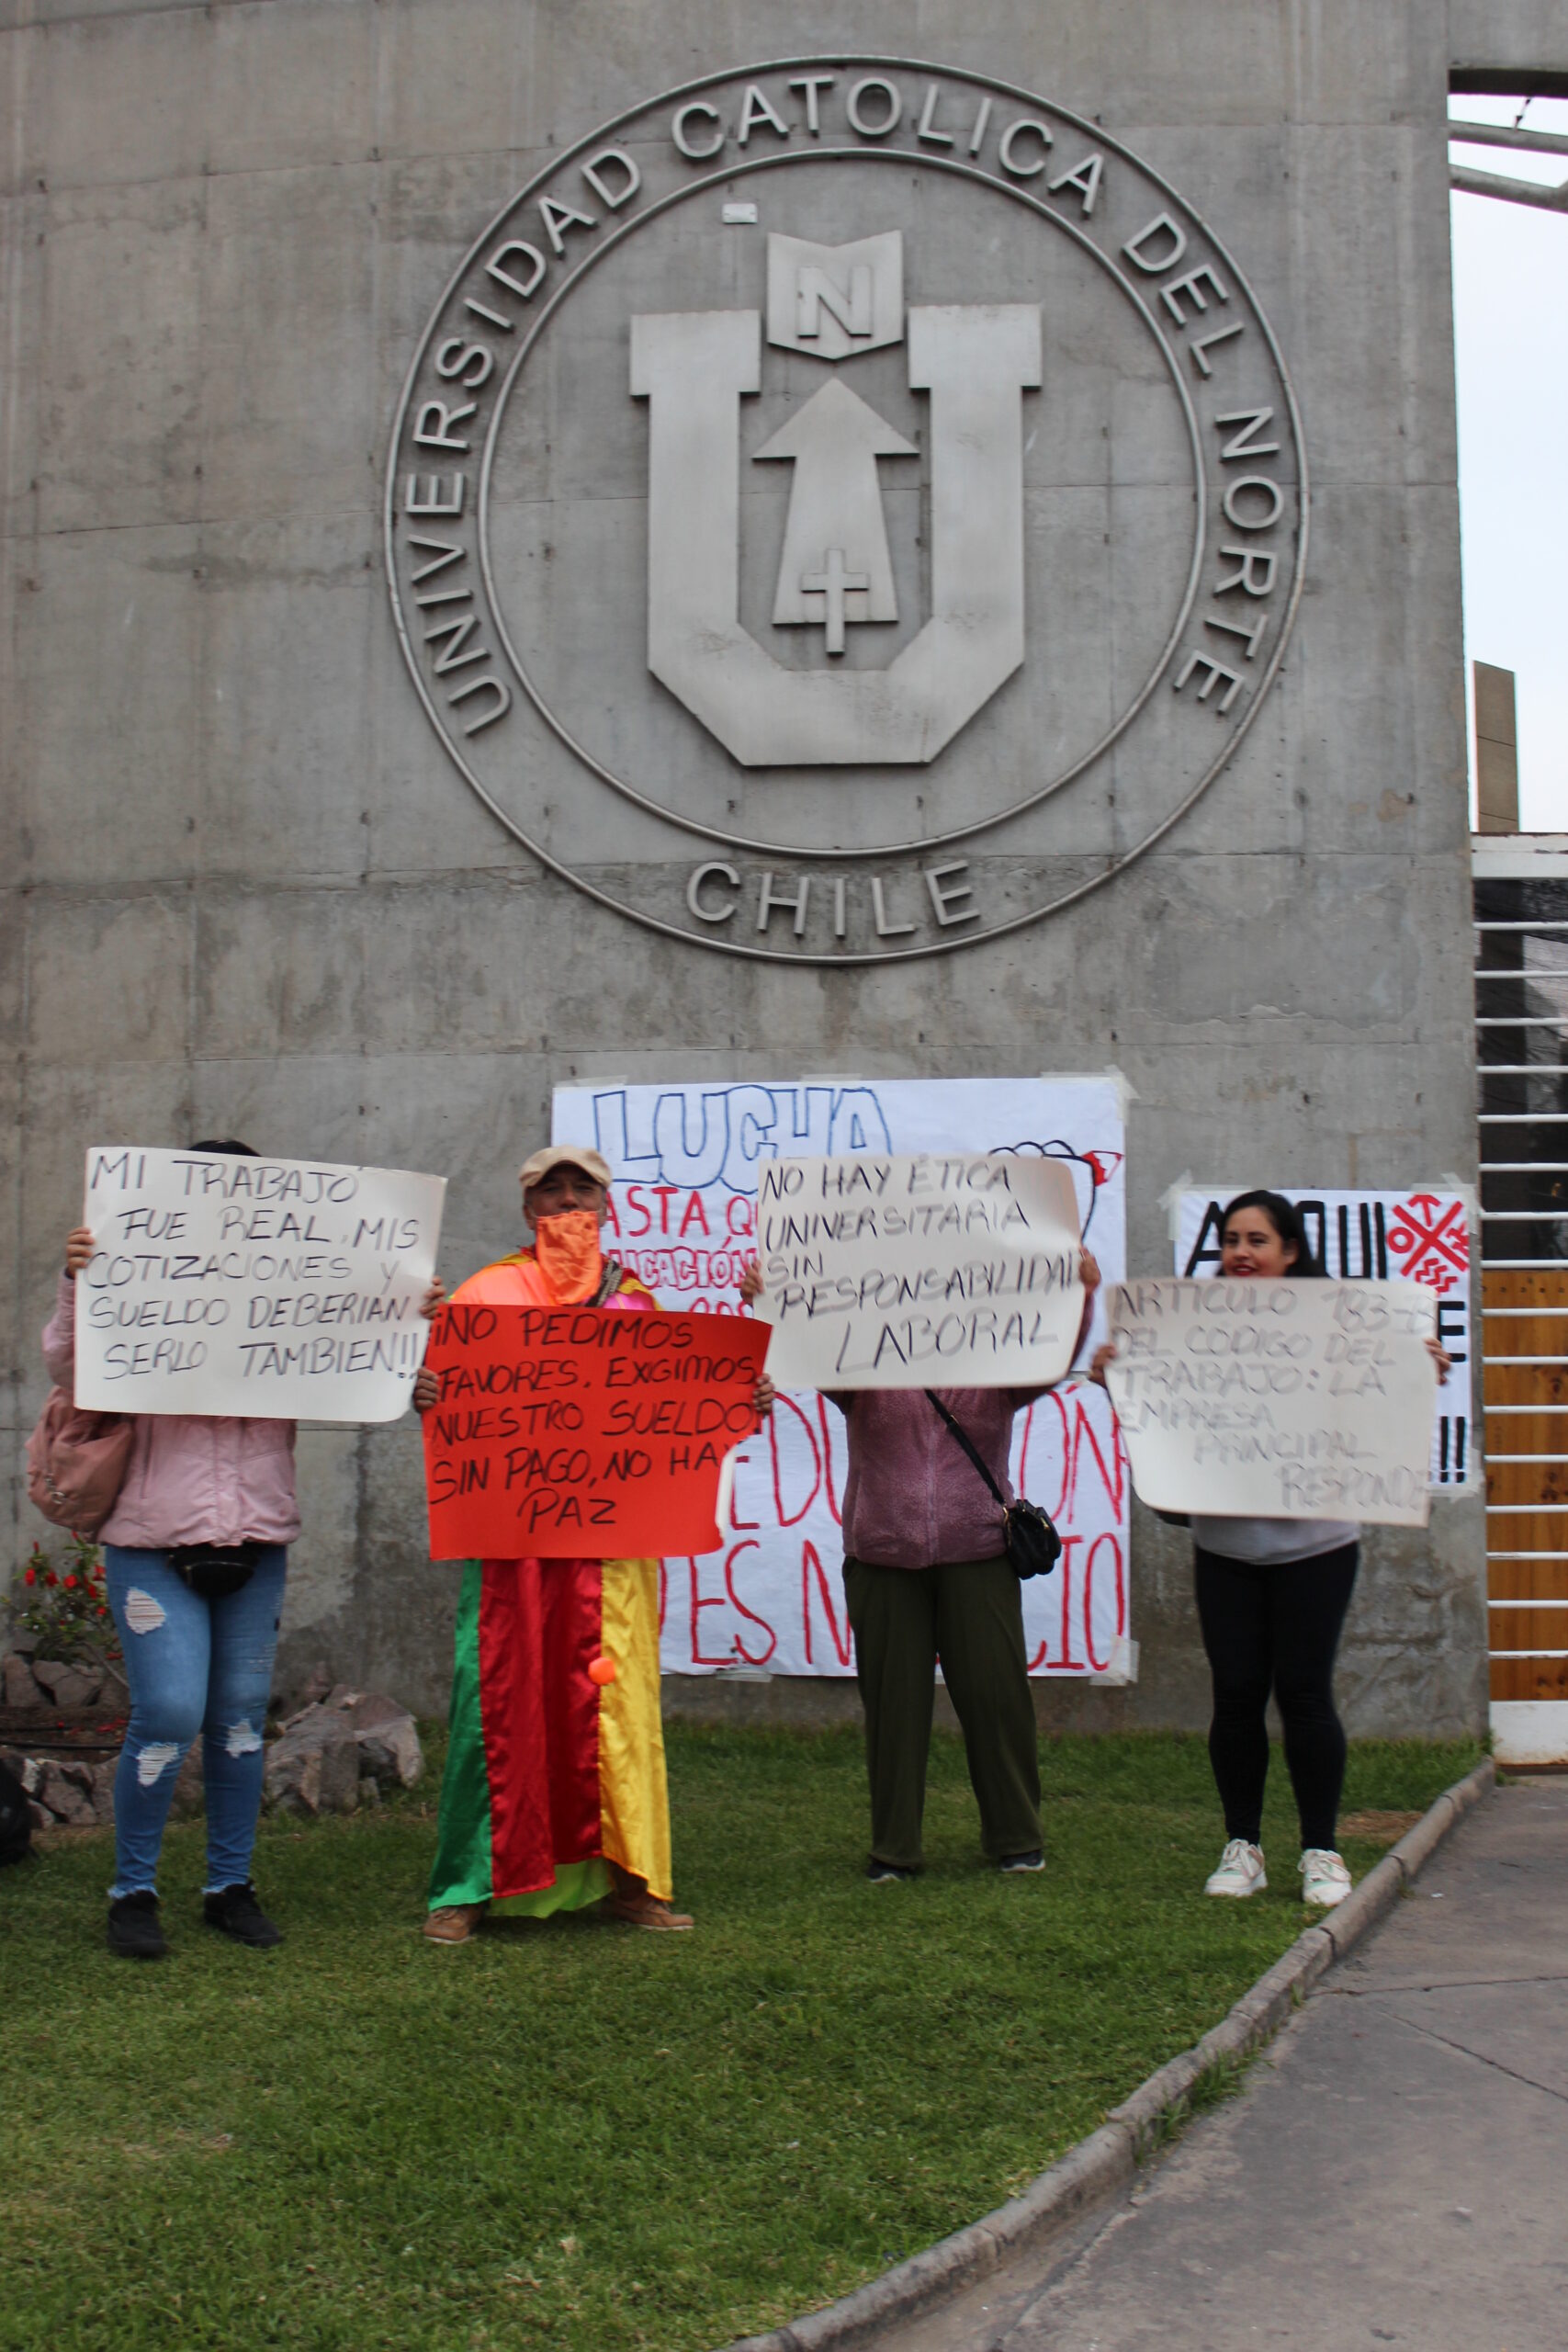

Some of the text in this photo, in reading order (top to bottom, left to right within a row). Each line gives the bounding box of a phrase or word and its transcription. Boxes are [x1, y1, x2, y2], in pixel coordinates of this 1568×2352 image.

[796, 265, 874, 340] N
[405, 74, 1282, 736] UNIVERSIDAD CATOLICA DEL NORTE
[684, 860, 982, 937] CHILE
[90, 1151, 359, 1204] MI TRABAJO
[761, 1164, 805, 1204] NO
[822, 1162, 892, 1197] HAY
[117, 1207, 189, 1241] FUE
[351, 1216, 420, 1252] MIS
[765, 1198, 1031, 1253] UNIVERSITARIA
[83, 1250, 355, 1288] COTIZACIONES
[765, 1250, 824, 1286] SIN
[88, 1292, 412, 1330] SUELDO DEBERIAN
[1114, 1282, 1298, 1323] ARTICULO
[519, 1308, 694, 1351] PEDIMOS
[835, 1306, 1059, 1374] LABORAL
[1324, 1331, 1397, 1367] DEL
[103, 1337, 209, 1381] SERLO
[1328, 1364, 1387, 1397] LA
[432, 1398, 584, 1447] NUESTRO
[430, 1457, 490, 1505] SIN
[603, 1448, 652, 1482] NO
[670, 1440, 740, 1476] HA
[517, 1487, 616, 1534] PAZ
